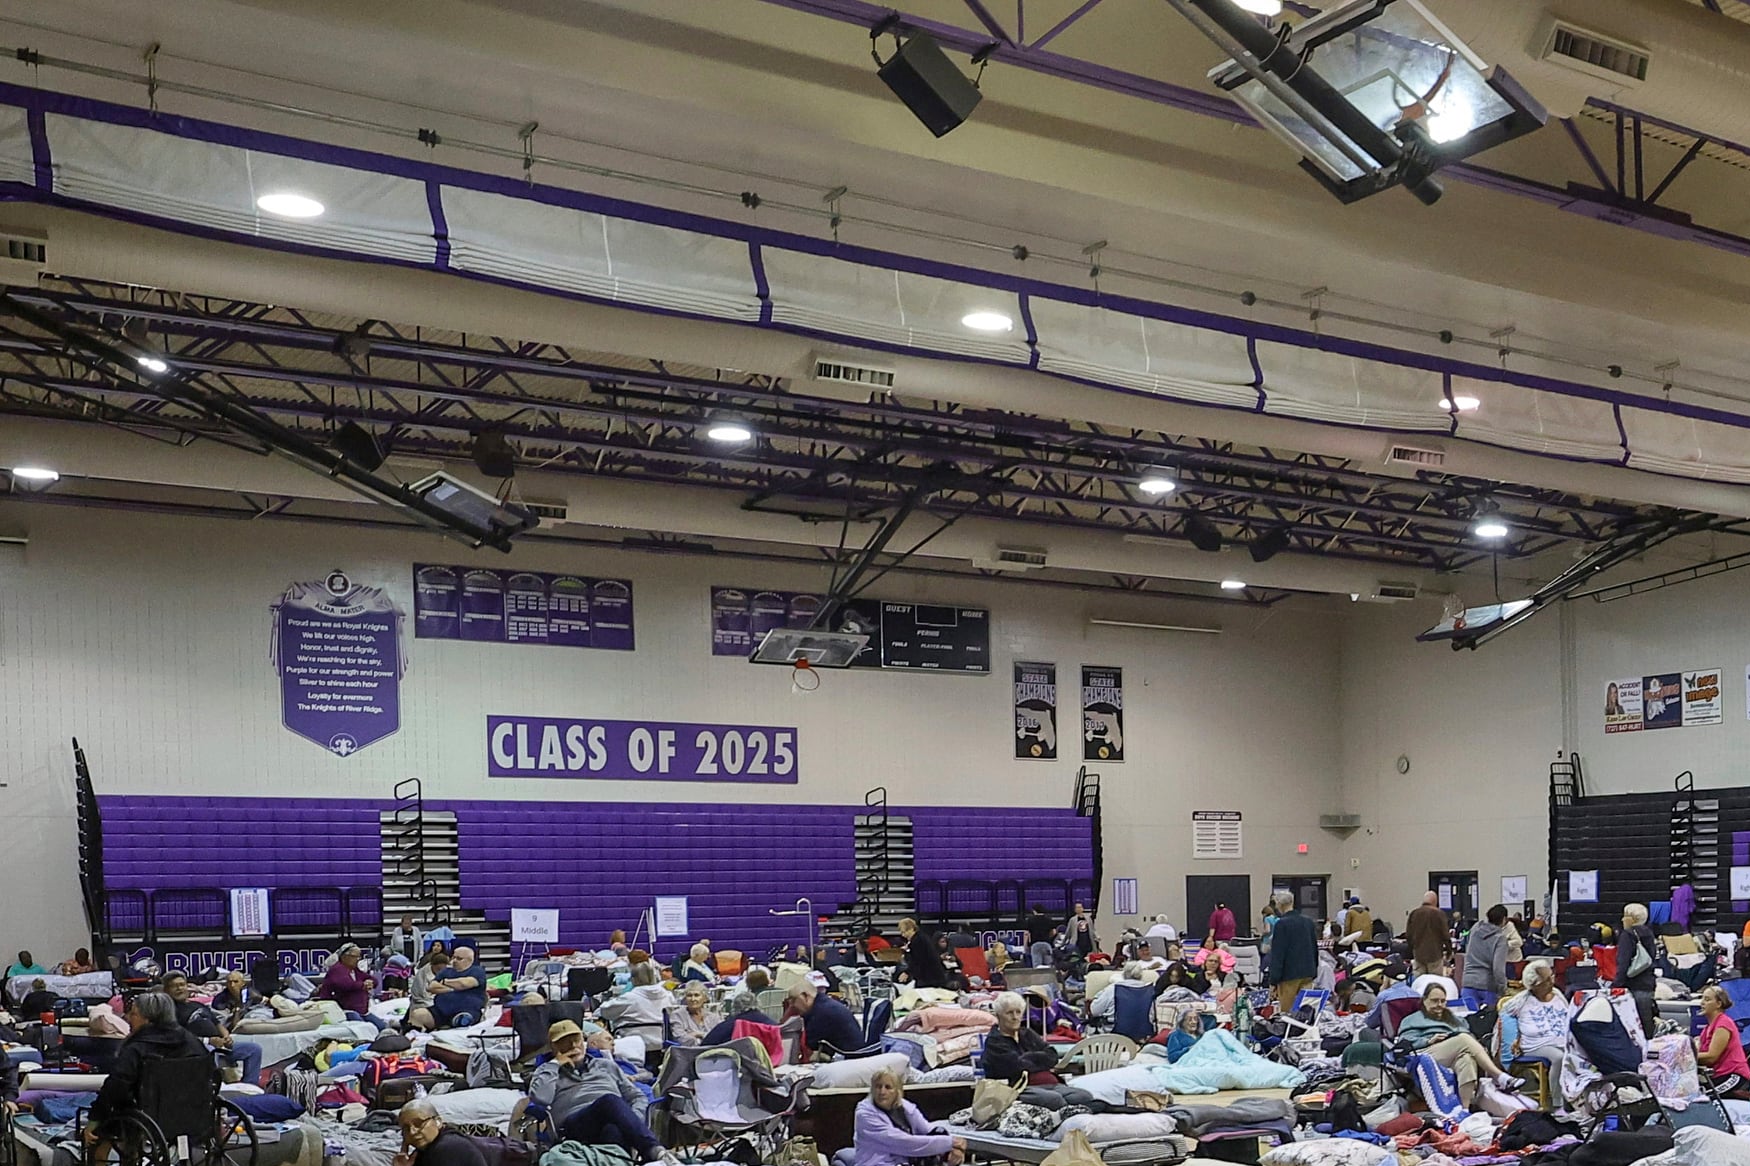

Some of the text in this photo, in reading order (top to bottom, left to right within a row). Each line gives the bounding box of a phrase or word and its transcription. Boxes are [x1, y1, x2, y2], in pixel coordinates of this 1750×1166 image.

[315, 602, 365, 614] ALMA MATER
[886, 605, 912, 613] GUEST
[343, 621, 361, 630] Royal
[363, 623, 389, 632] Knights
[317, 656, 345, 665] reaching
[286, 666, 307, 674] Purple
[1022, 673, 1048, 683] STATE
[1089, 677, 1114, 686] STATE
[307, 692, 331, 701] Loyalty
[1015, 682, 1056, 707] CHAMPIONS
[1083, 686, 1122, 710] CHAMPIONS
[312, 704, 336, 712] Knights
[491, 722, 794, 775] CLASS OF 2025
[521, 927, 548, 935] Middle
